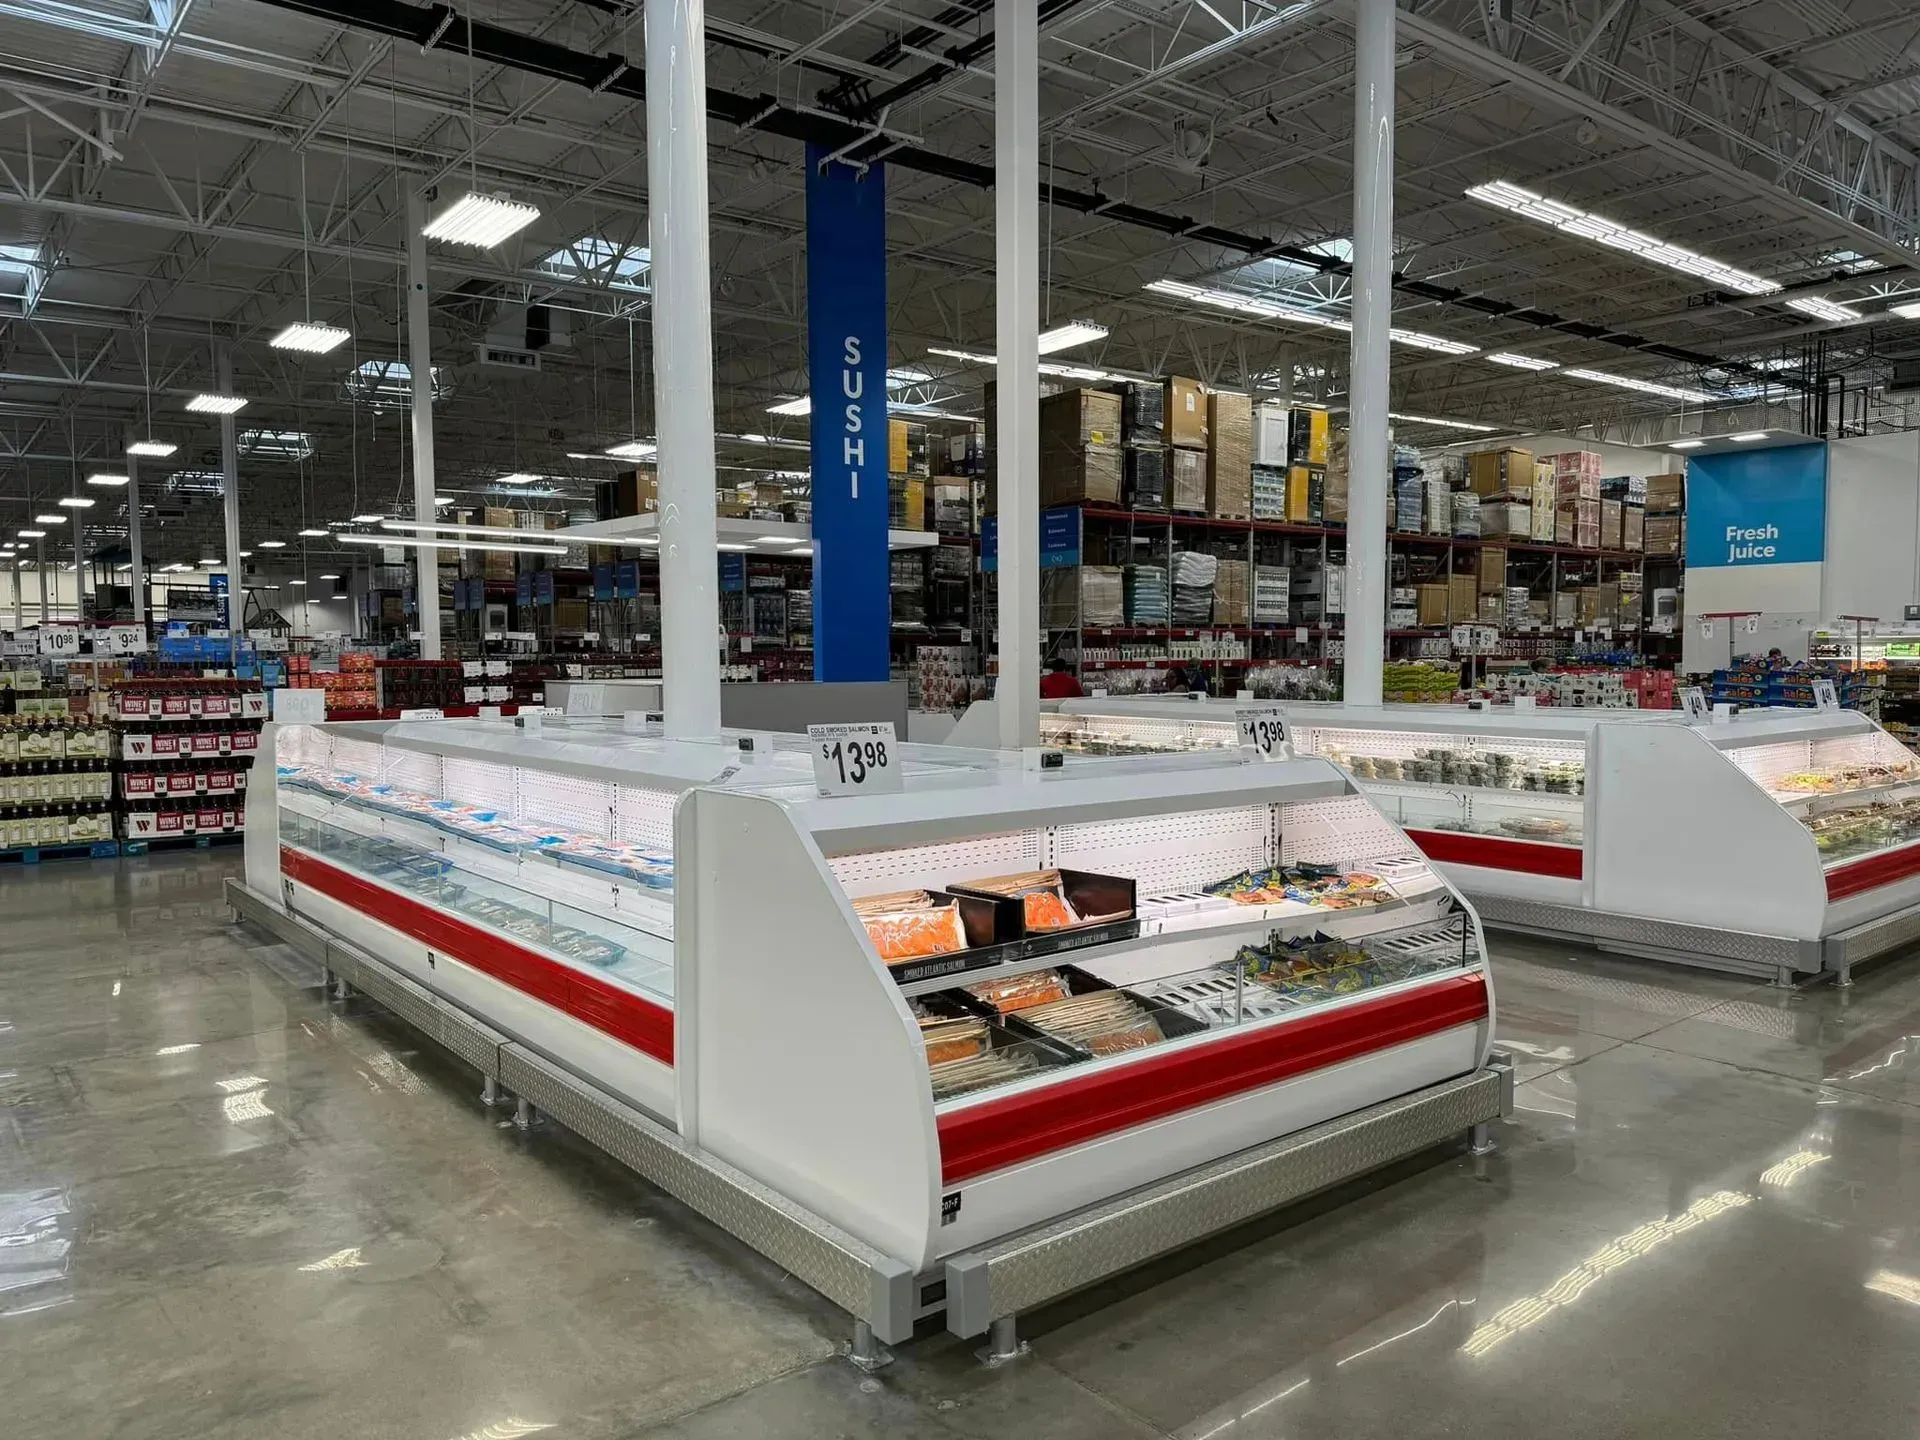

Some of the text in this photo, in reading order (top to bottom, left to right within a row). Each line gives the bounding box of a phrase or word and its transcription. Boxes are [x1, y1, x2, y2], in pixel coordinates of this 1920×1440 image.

[843, 336, 864, 498] SUSHI
[1726, 524, 1778, 541] Fresh
[1728, 542, 1776, 562] Juice
[1243, 721, 1284, 754] $1398
[822, 742, 888, 784] $1398
